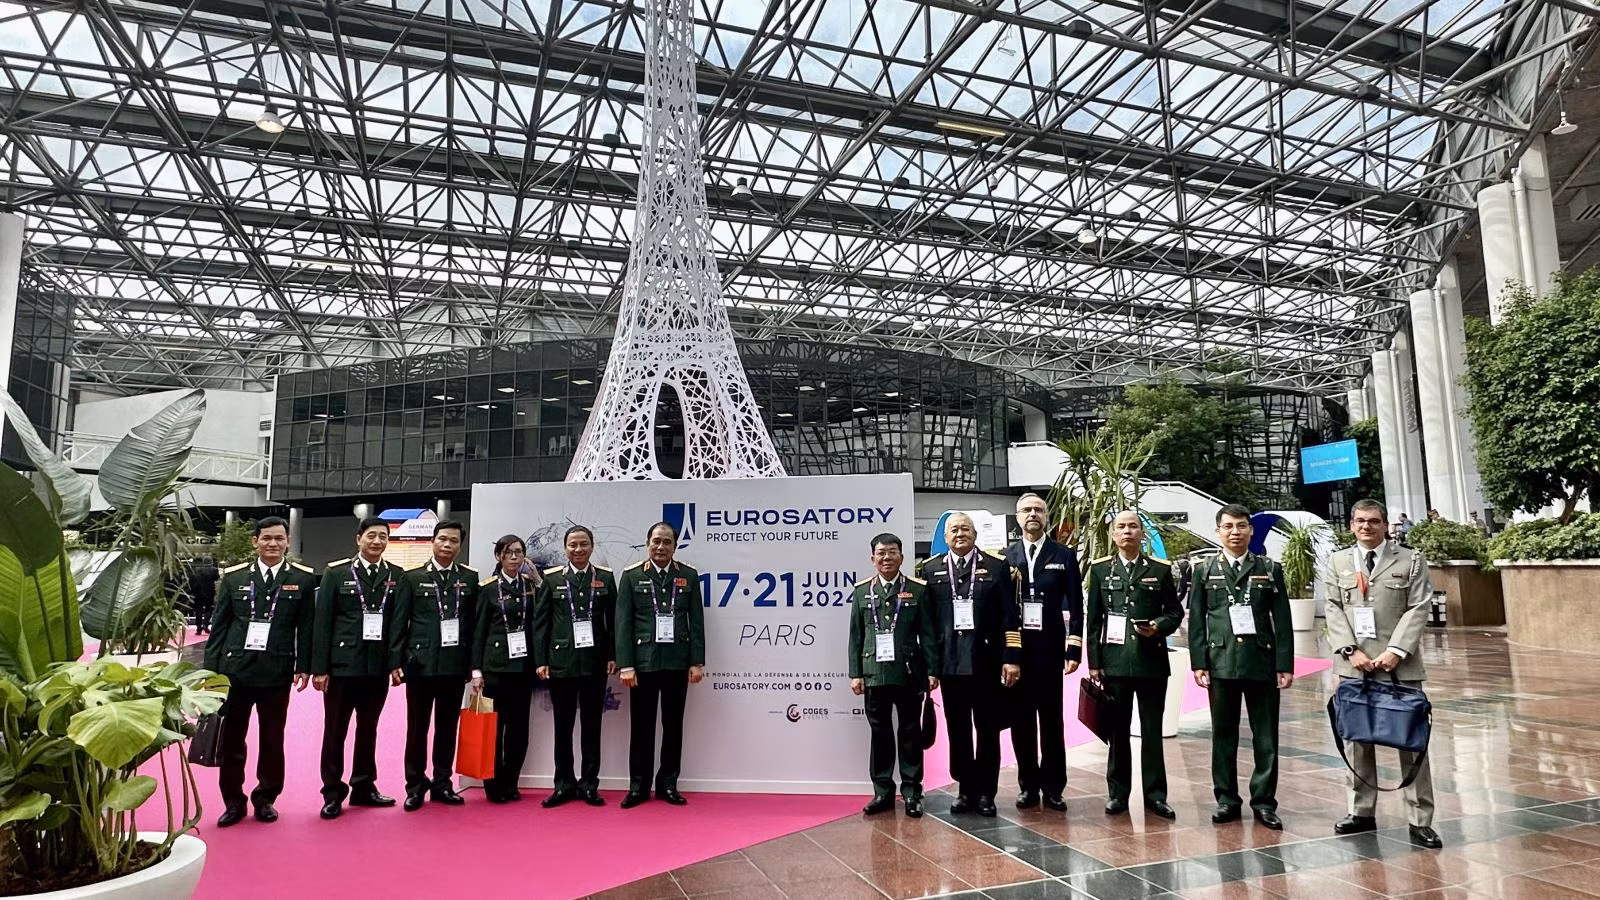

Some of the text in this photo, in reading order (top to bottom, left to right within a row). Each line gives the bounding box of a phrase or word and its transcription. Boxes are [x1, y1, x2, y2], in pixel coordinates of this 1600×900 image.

[706, 507, 894, 527] EUROSATORY
[706, 531, 839, 542] PROTECT YOUR FUTURE
[802, 571, 857, 588] JUIN
[739, 624, 817, 647] PARIS
[713, 682, 791, 690] EUROSATORY.COM
